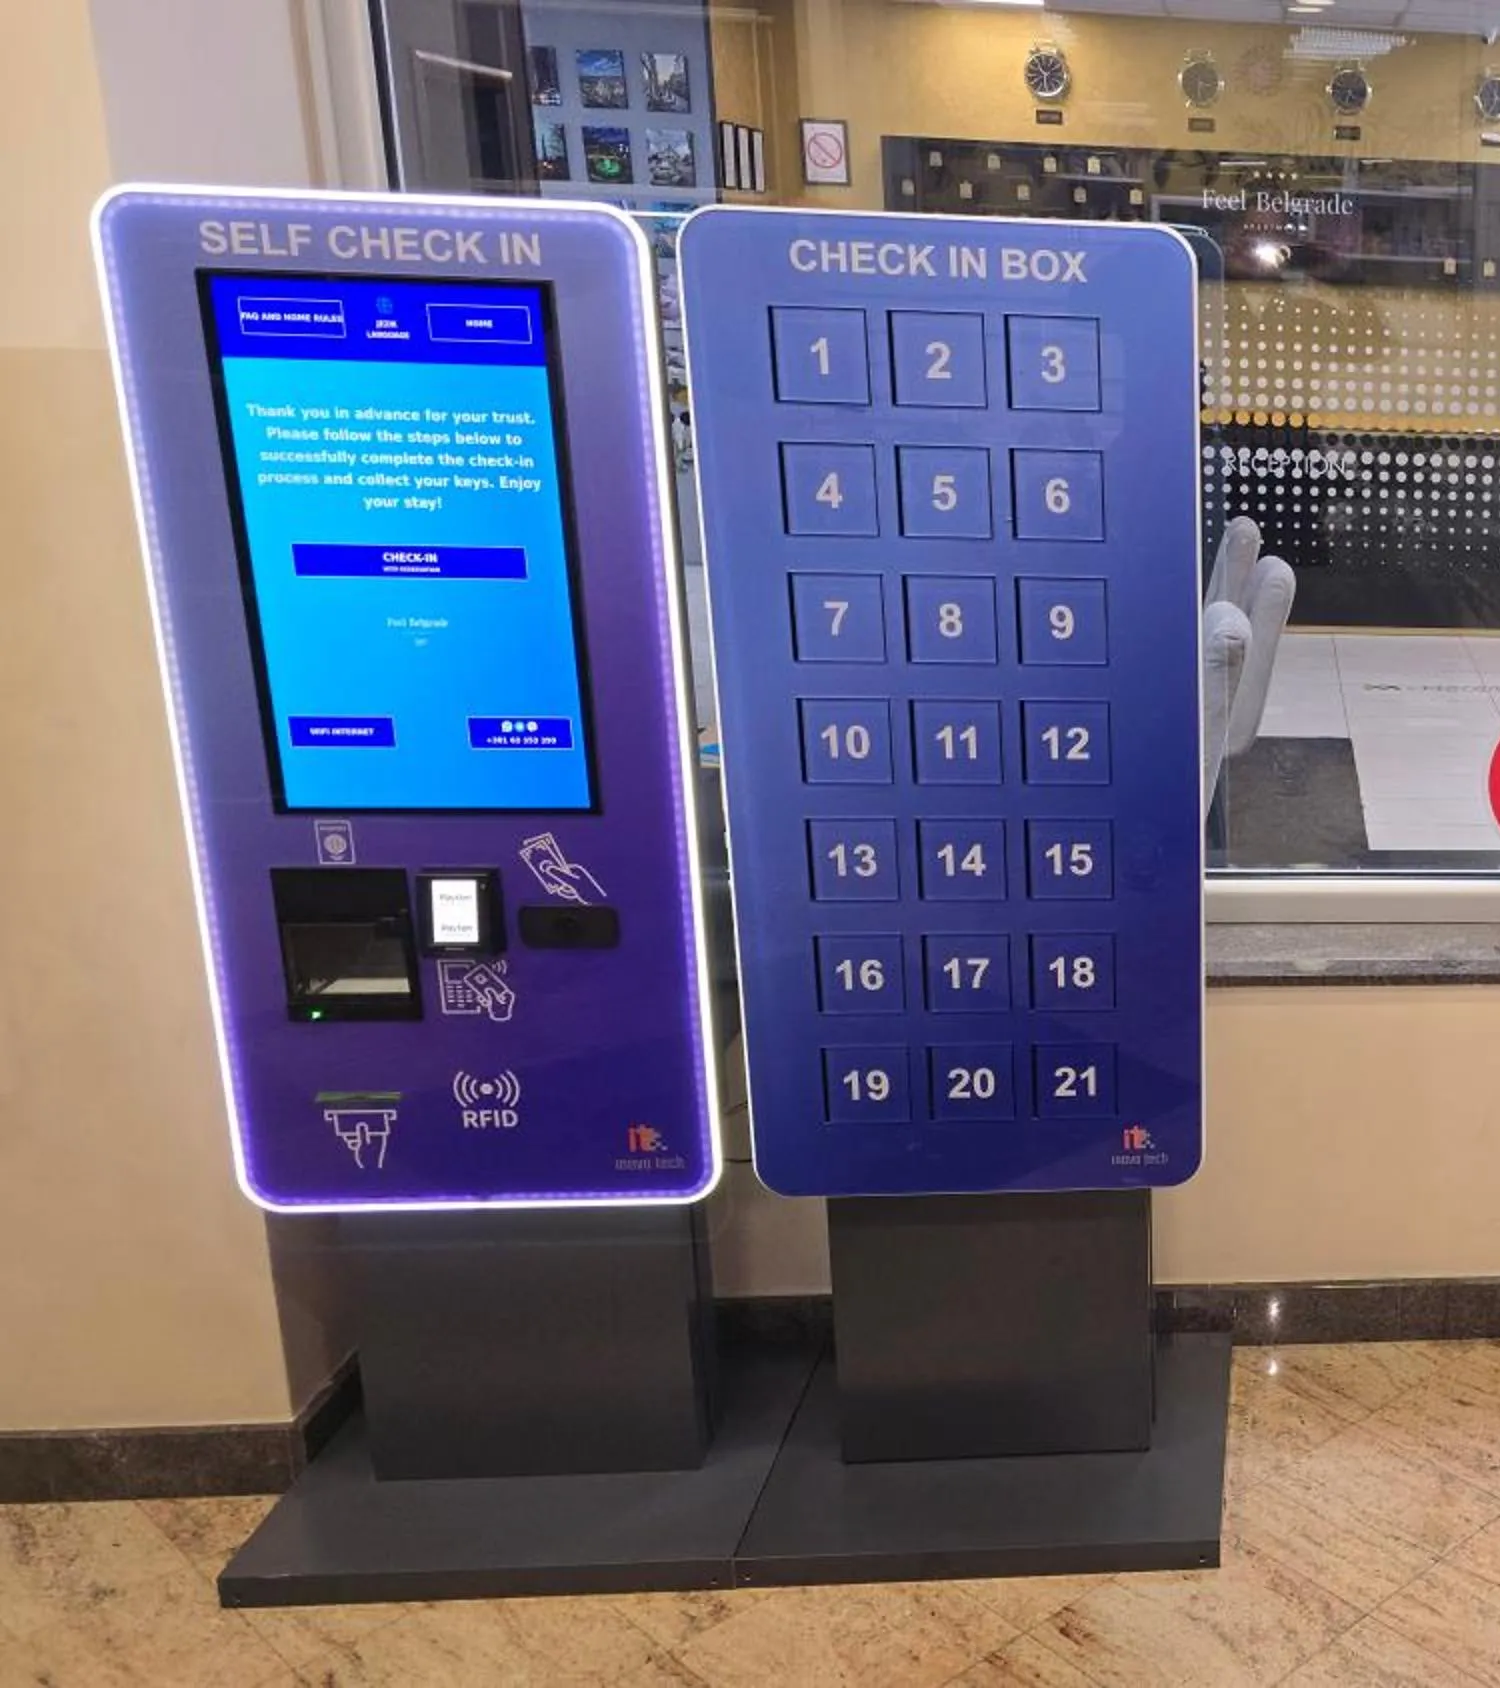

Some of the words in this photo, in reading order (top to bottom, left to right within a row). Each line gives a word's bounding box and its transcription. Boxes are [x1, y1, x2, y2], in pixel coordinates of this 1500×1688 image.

[1202, 188, 1247, 211] Feel
[1257, 190, 1354, 216] Belgrade
[199, 220, 312, 257] SELF
[327, 225, 487, 265] CHECK
[499, 231, 541, 267] IN
[789, 239, 936, 277] CHECK
[949, 245, 987, 280] IN
[1001, 247, 1087, 283] BOX
[810, 337, 830, 375] 1
[925, 341, 952, 380] 2
[1041, 345, 1066, 383] 3
[246, 403, 296, 418] Thank
[302, 407, 331, 421] you
[335, 406, 350, 419] in
[355, 407, 421, 421] advance
[425, 408, 448, 422] for
[452, 411, 489, 425] your
[492, 411, 536, 425] trust.
[266, 426, 320, 440] Please
[323, 427, 373, 442] follow
[376, 429, 403, 443] the
[407, 430, 451, 446] steps
[454, 431, 501, 445] below
[505, 433, 523, 446] to
[260, 449, 357, 467] successfully
[361, 451, 434, 468] complete
[438, 452, 465, 467] the
[469, 453, 535, 468] check-in
[1225, 453, 1347, 475] RECEPTION
[258, 473, 320, 487] process
[323, 473, 354, 485] and
[357, 472, 410, 488] collect
[414, 474, 450, 489] your
[453, 474, 495, 491] keys.
[499, 475, 541, 492] Enjoy
[815, 472, 843, 509] 4
[932, 475, 957, 512] 5
[1045, 478, 1070, 514] 6
[363, 497, 400, 512] your
[404, 496, 443, 512] stay!
[383, 551, 439, 563] CHECK-IN
[824, 601, 849, 636] 7
[939, 603, 963, 638] 8
[1049, 605, 1075, 640] 9
[821, 724, 871, 760] 10
[936, 725, 978, 760] 11
[1042, 726, 1090, 760] 12
[828, 843, 877, 877] 13
[937, 844, 987, 877] 14
[1045, 843, 1093, 877] 15
[836, 959, 885, 991] 16
[943, 957, 990, 989] 17
[1049, 956, 1095, 989] 18
[843, 1069, 890, 1101] 19
[948, 1067, 995, 1099] 20
[1054, 1066, 1097, 1097] 21
[462, 1110, 518, 1129] RFID
